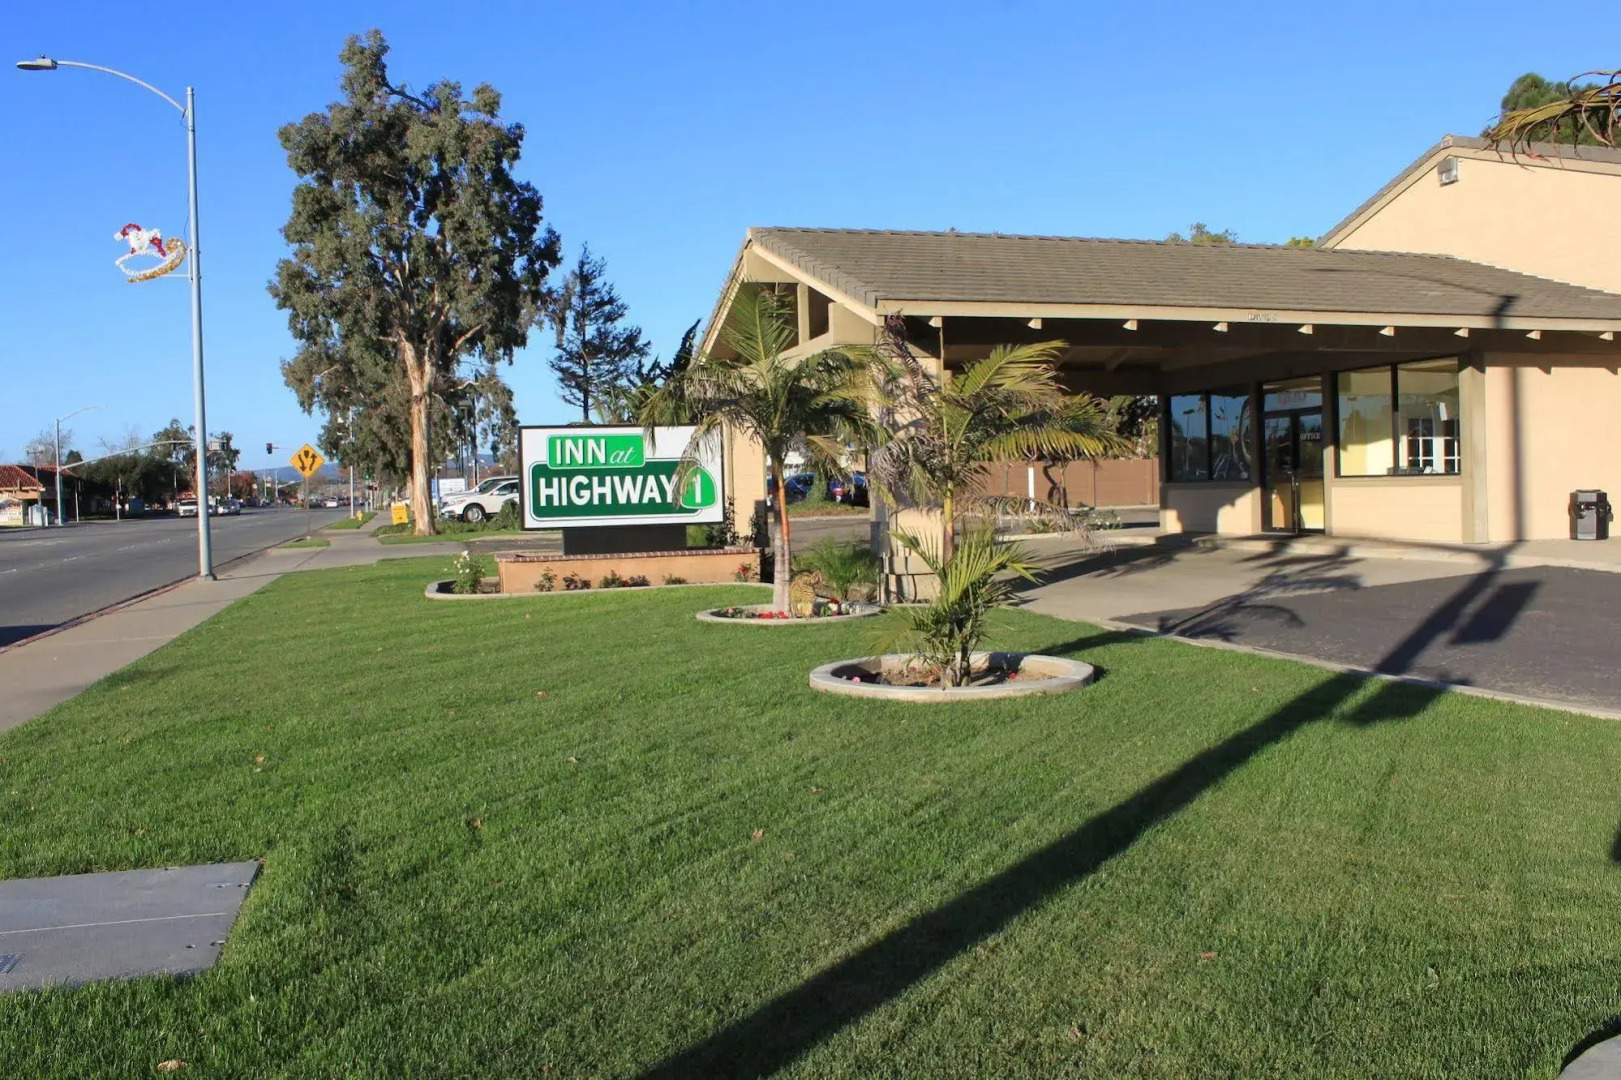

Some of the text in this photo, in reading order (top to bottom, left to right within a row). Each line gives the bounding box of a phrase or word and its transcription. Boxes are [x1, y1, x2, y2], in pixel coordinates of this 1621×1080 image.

[555, 438, 636, 465] INN at
[539, 474, 702, 507] HIGHWAY 1
